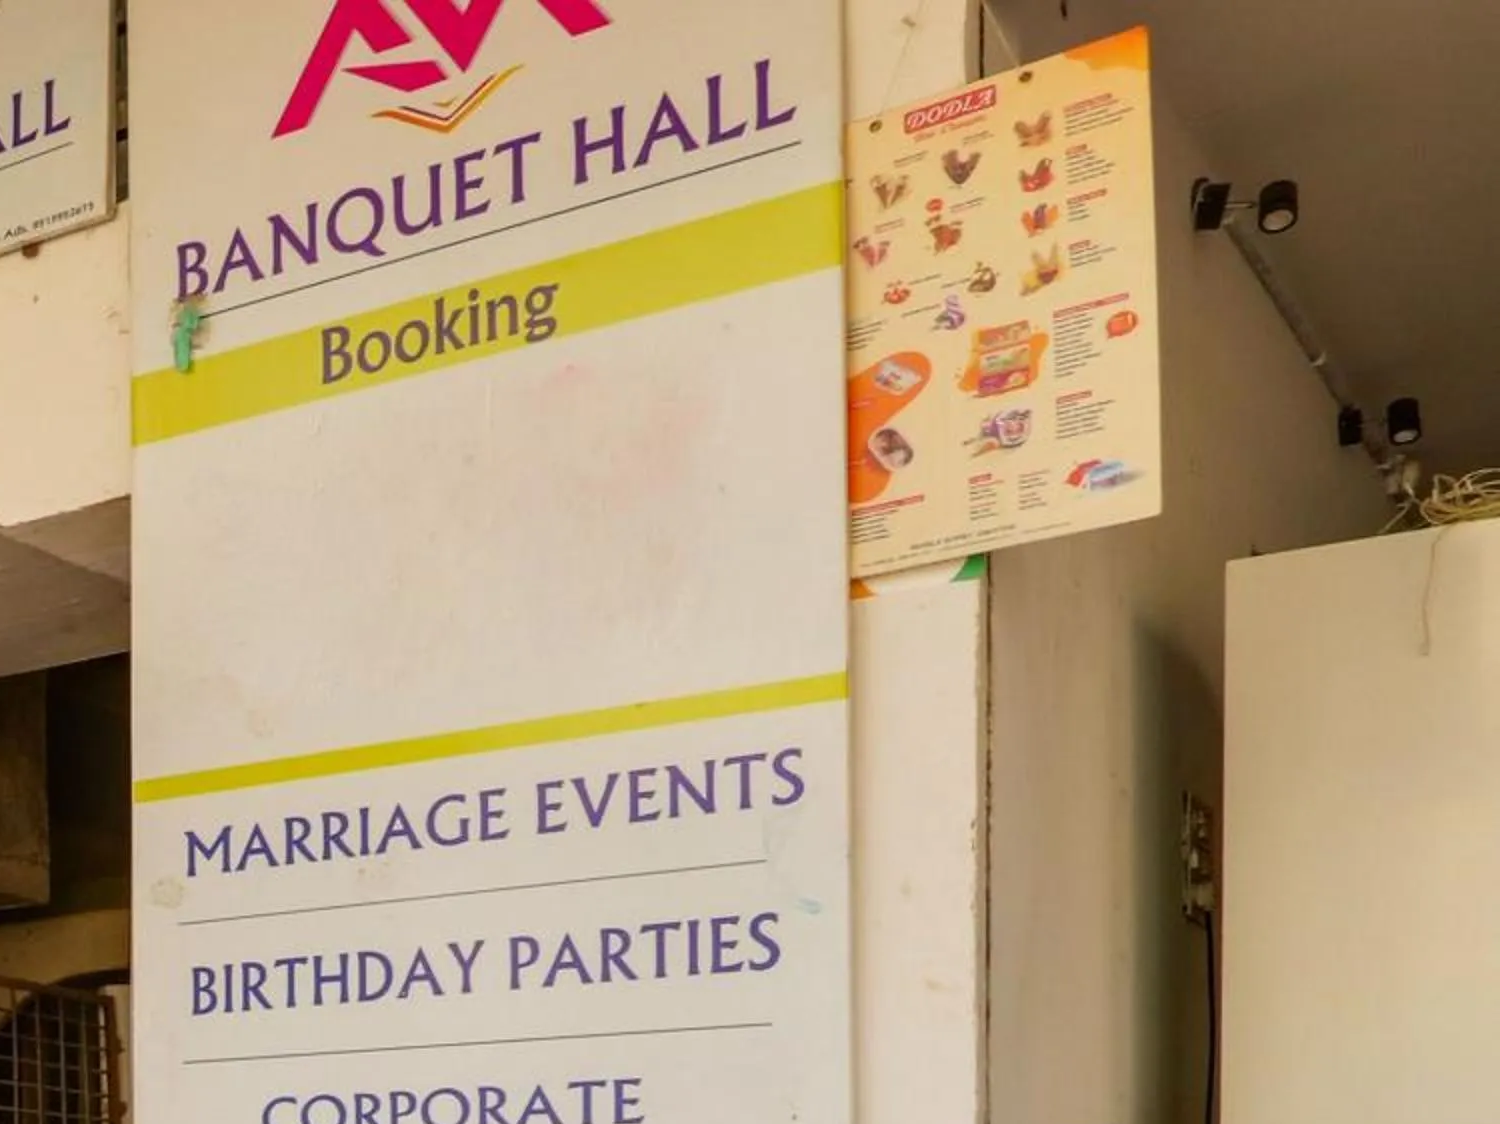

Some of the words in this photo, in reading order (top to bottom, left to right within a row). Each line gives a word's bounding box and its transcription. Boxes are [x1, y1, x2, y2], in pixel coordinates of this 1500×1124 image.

[176, 132, 542, 303] BANQUET
[572, 59, 798, 186] HALL
[320, 283, 561, 386] Booking
[183, 788, 510, 878] MARRIAGE
[535, 748, 805, 836] EVENTS
[190, 939, 485, 1017] BIRTHDAY
[508, 912, 782, 991] PARTIES
